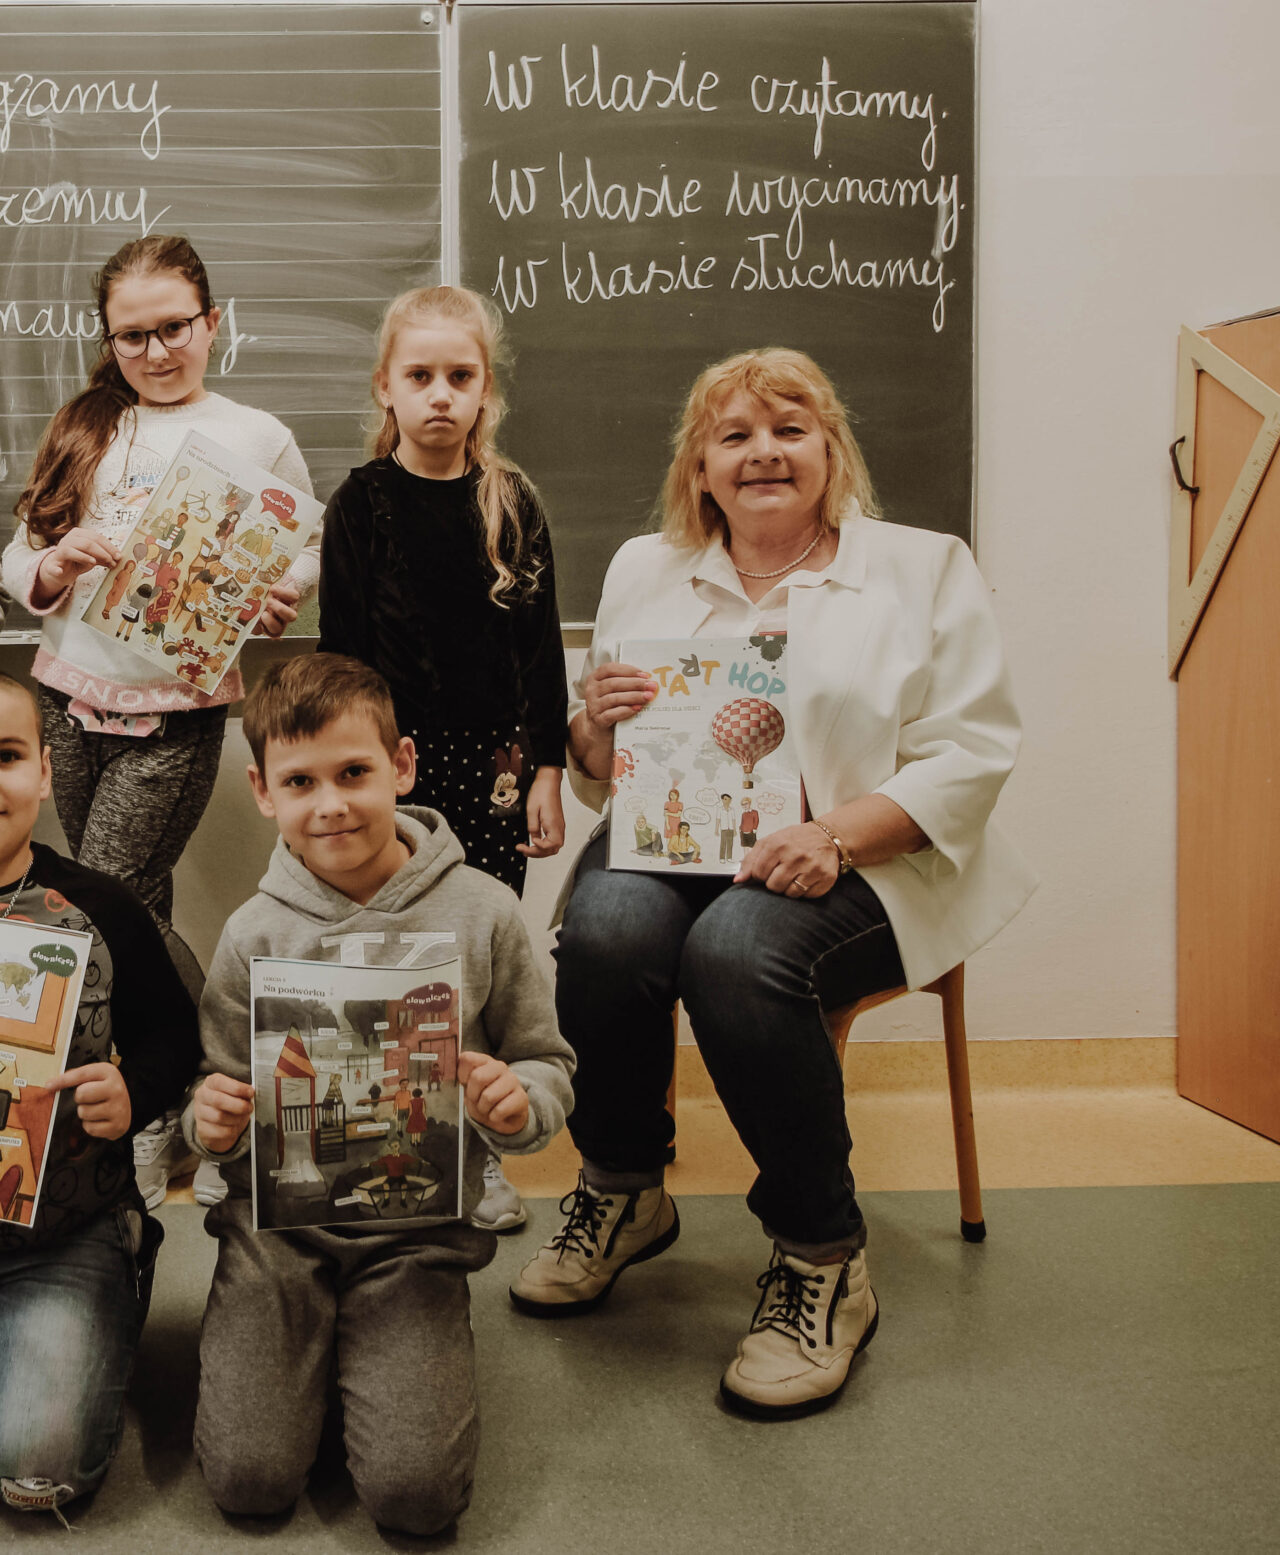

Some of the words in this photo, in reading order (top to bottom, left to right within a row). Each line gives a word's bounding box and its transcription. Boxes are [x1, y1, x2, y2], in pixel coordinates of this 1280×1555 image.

[485, 51, 542, 112] W
[562, 43, 719, 112] klasie
[750, 57, 947, 171] czytamy.
[489, 160, 546, 220] W
[560, 152, 703, 222] klasie
[726, 160, 965, 259] wycinamy.
[492, 256, 548, 313] W
[562, 242, 717, 303] klasie
[641, 653, 721, 702] TART
[728, 661, 786, 699] HOP
[263, 984, 277, 993] Na
[278, 985, 326, 998] podwórku
